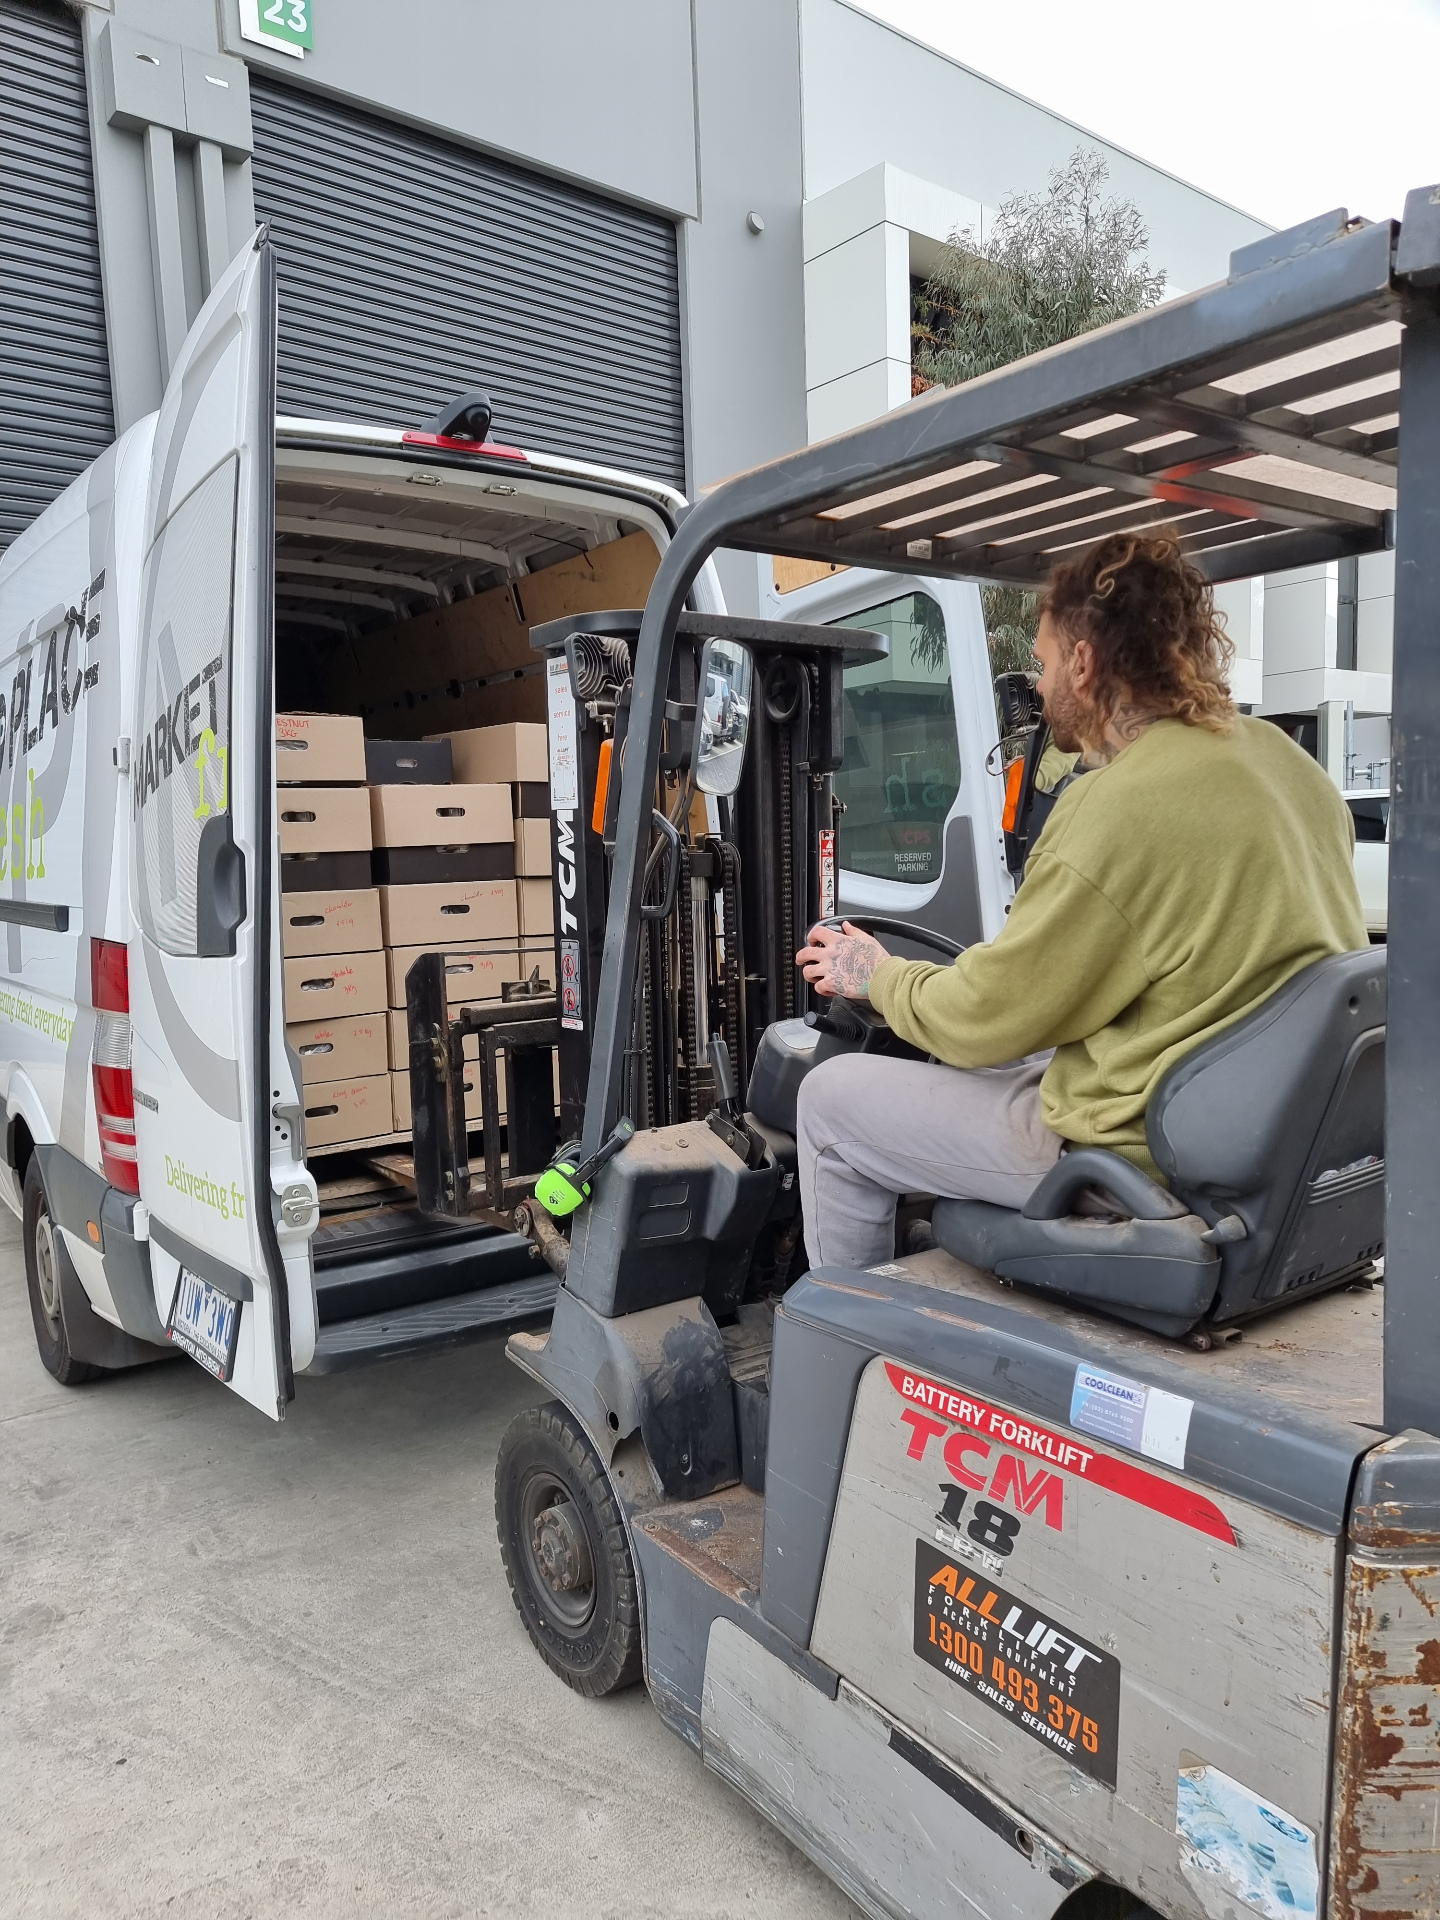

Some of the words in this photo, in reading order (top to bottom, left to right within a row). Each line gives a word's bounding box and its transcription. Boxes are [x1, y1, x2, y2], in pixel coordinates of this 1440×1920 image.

[263, 0, 307, 33] 23
[133, 653, 223, 823] MARKET
[556, 809, 578, 935] TCM
[894, 852, 932, 863] RESERVED
[897, 862, 929, 873] PARKING
[15, 991, 33, 1026] fresh
[165, 1154, 230, 1221] Delivering
[231, 1181, 246, 1220] fr
[902, 1376, 986, 1426] BATTERY
[989, 1413, 1093, 1473] FORKLIFT
[1085, 1377, 1134, 1402] COOLCLEAN
[900, 1408, 1064, 1533] TCM
[935, 1483, 1021, 1557] 18
[928, 1612, 984, 1676] 1300
[991, 1655, 1040, 1714] 493
[1047, 1693, 1099, 1754] 375
[943, 1606, 988, 1642] ACCESS
[998, 1641, 1075, 1698] EQUIPMENT
[944, 1657, 971, 1683] HIRE
[976, 1679, 1015, 1713] SALES
[1020, 1710, 1077, 1756] SERVICE
